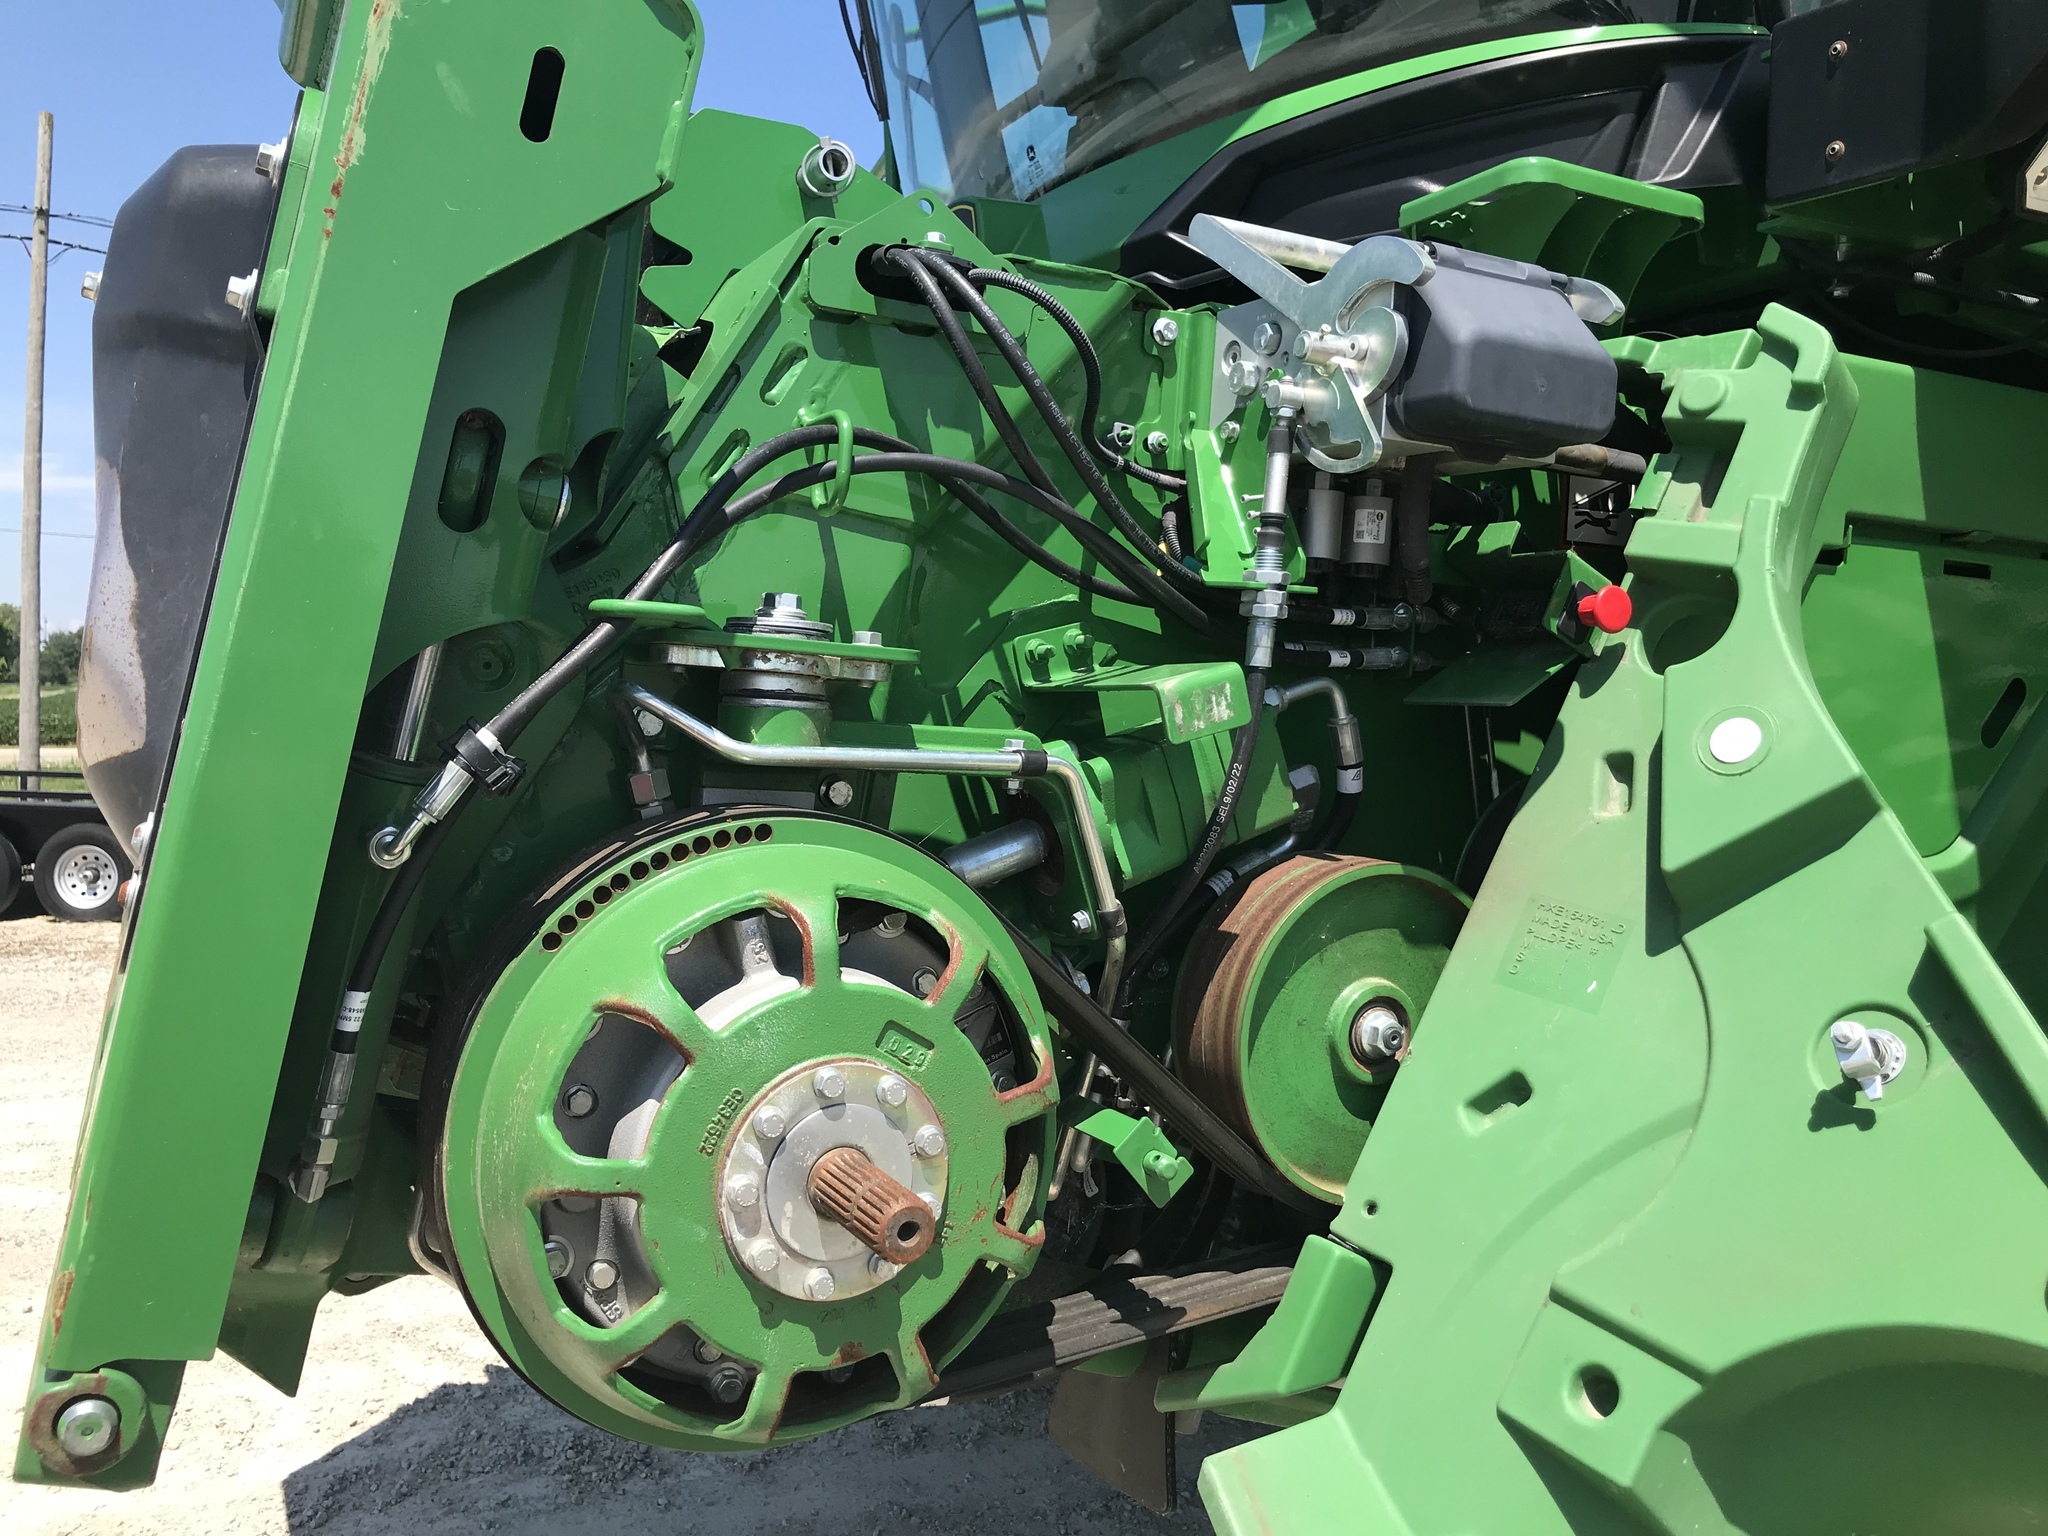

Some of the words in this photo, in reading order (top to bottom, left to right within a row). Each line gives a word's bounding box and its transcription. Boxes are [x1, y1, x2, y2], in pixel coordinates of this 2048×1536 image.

[981, 304, 999, 323] 857
[1021, 360, 1036, 375] DN
[1033, 378, 1042, 388] 6
[1047, 401, 1068, 428] MSHA
[1117, 507, 1134, 529] MADE
[1215, 762, 1243, 824] SEL9/02/22
[1531, 914, 1571, 934] MADE
[1587, 932, 1616, 948] USA
[991, 1047, 1009, 1061] Spain
